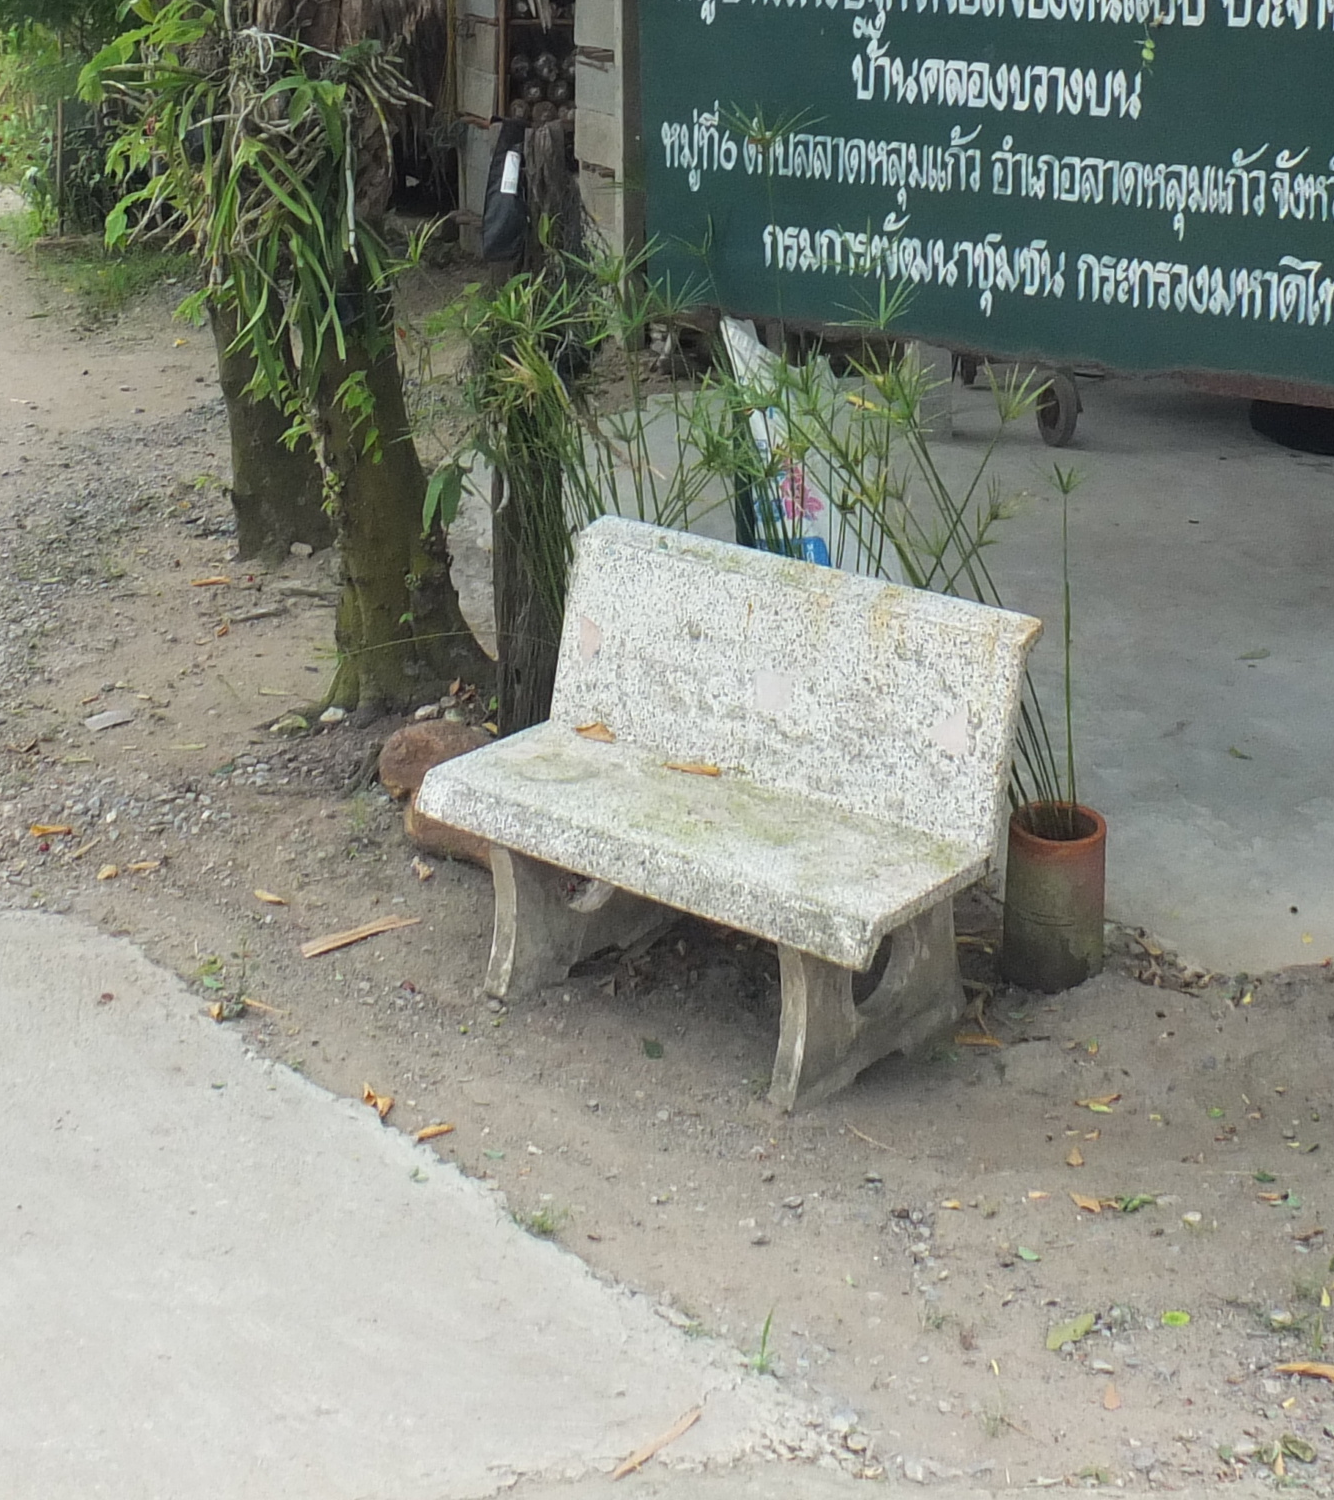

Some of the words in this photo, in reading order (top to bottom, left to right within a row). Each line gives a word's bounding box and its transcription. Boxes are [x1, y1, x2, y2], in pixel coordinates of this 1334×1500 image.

[851, 38, 1143, 120] บ้านคลองขวางบน
[762, 210, 1066, 318] กรมการพัฒนาชุมชน
